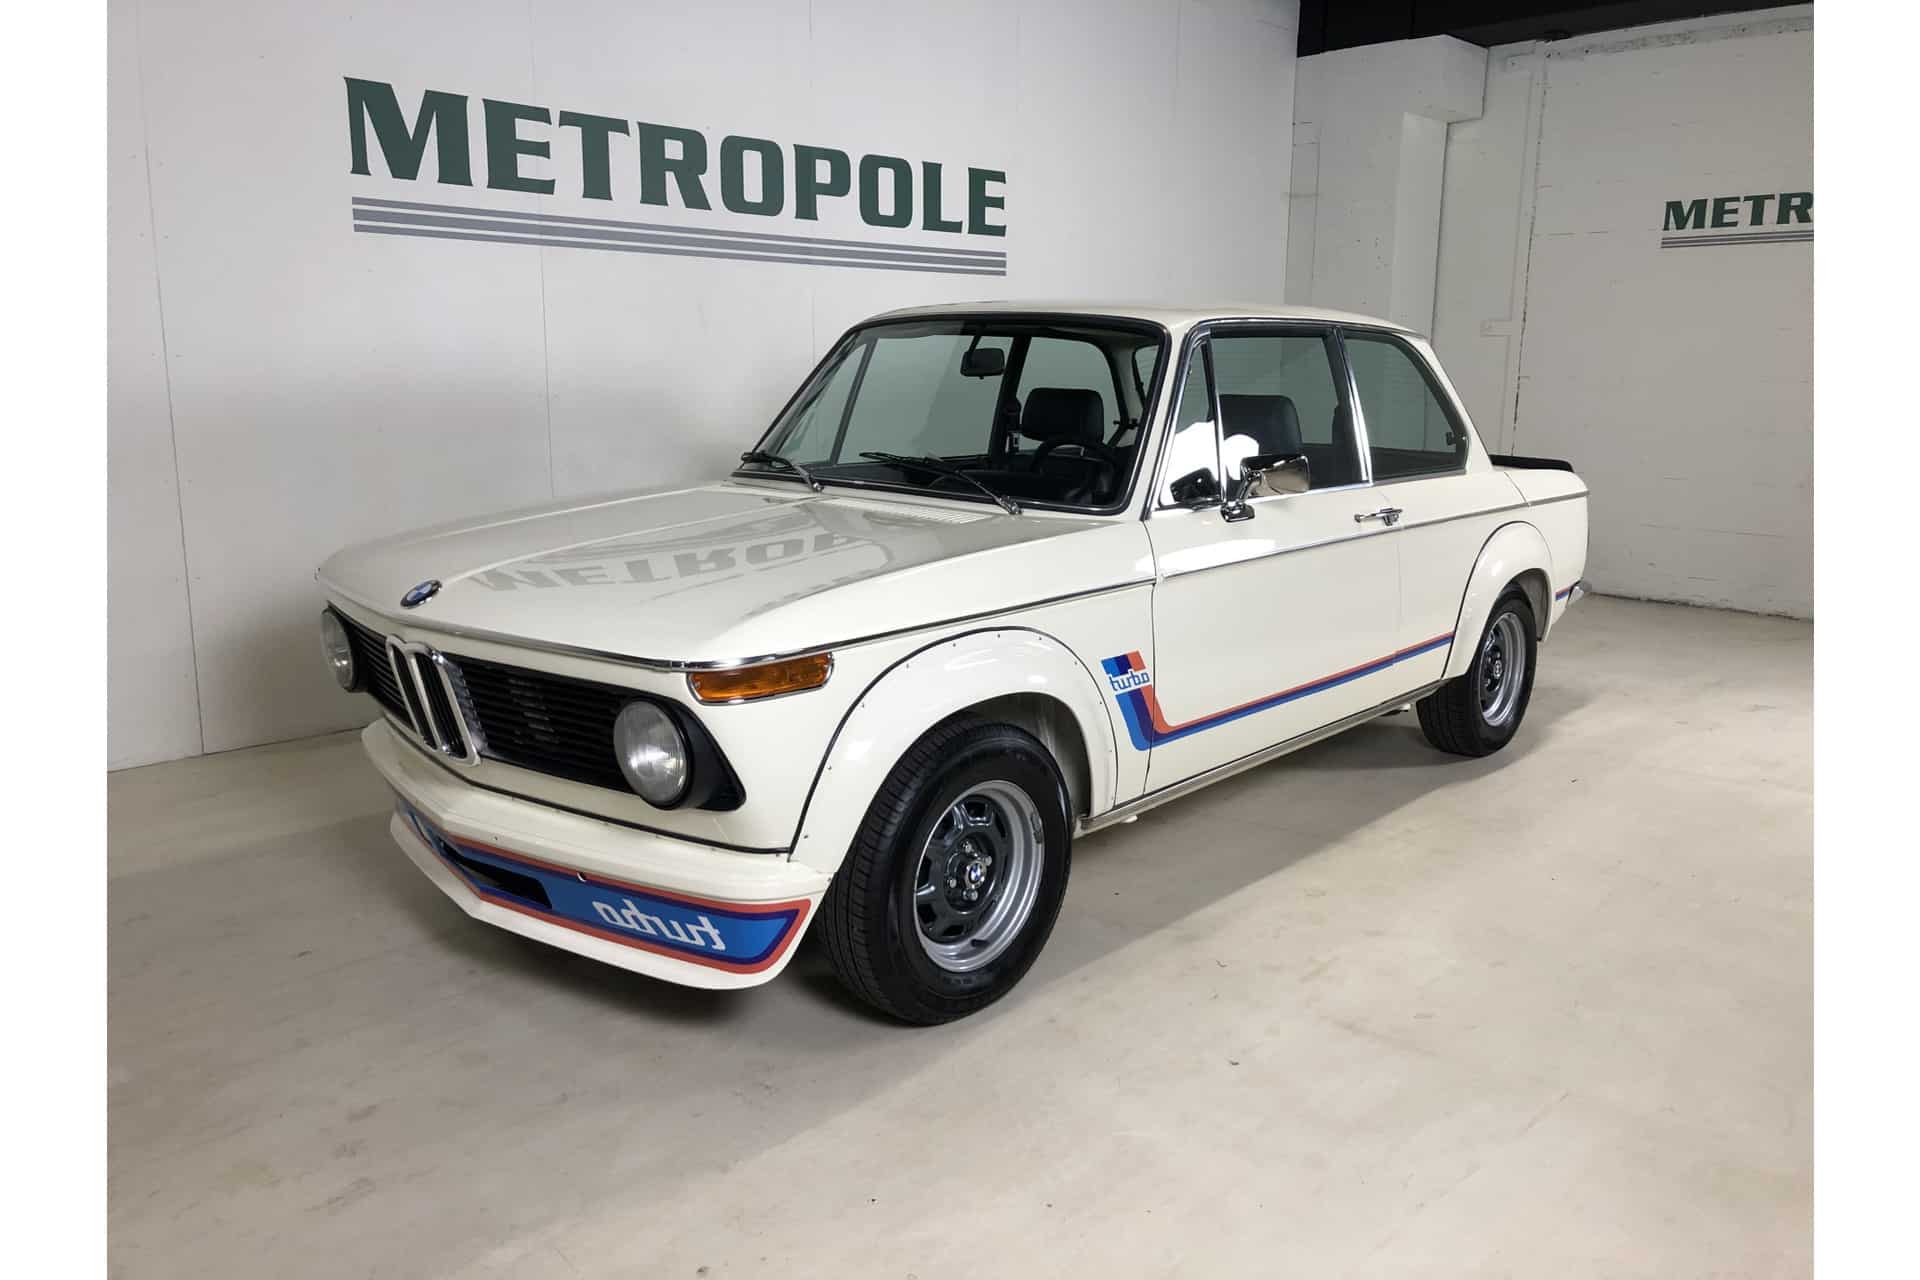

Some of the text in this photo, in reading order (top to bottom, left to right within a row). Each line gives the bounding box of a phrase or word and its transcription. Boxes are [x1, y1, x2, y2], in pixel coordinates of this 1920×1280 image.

[344, 76, 1007, 236] METROPOLE
[1663, 192, 1813, 231] METR
[1108, 670, 1150, 692] turbo
